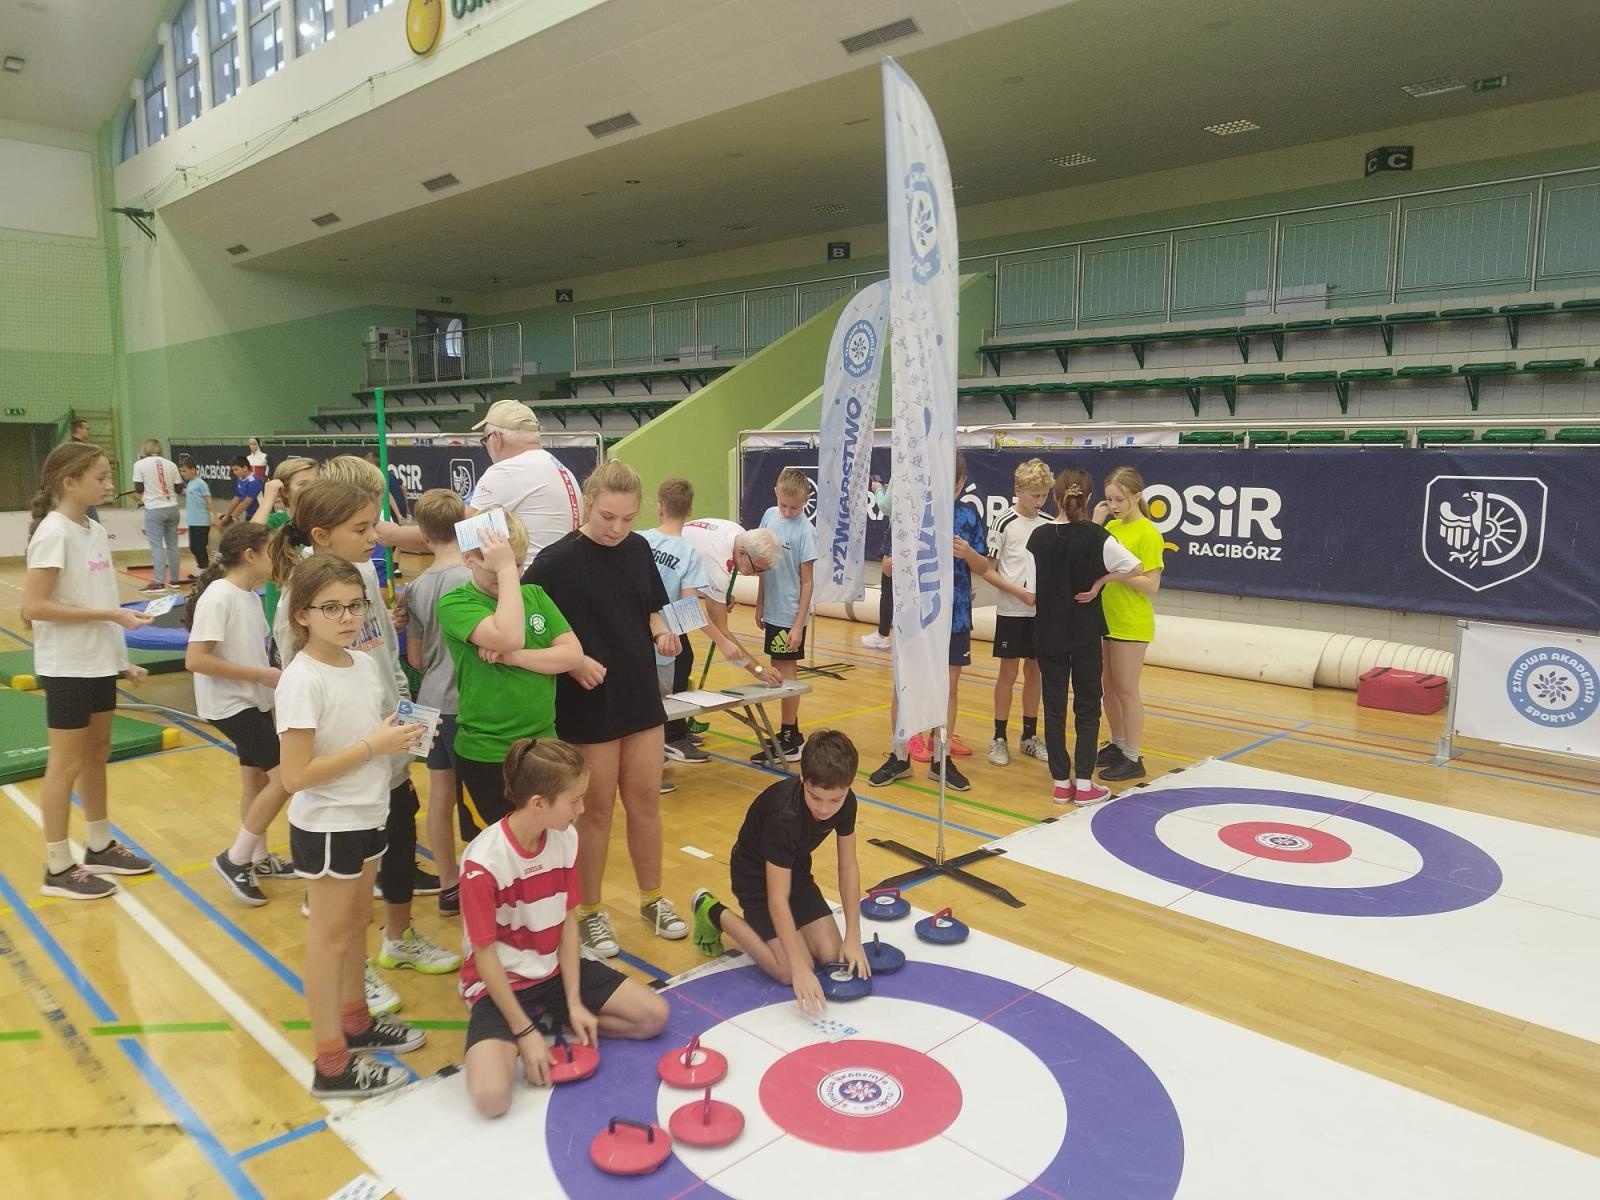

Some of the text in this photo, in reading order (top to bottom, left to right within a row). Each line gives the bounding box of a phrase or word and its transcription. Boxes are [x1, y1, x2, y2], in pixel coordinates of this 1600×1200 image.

[1388, 154, 1407, 168] C
[832, 247, 845, 258] B
[559, 293, 569, 301] A
[1142, 483, 1283, 541] OSiR
[1188, 540, 1282, 561] RACIBÓRZ
[1512, 652, 1595, 704] ZIMOWA AKADEMIA
[1524, 705, 1576, 723] SPORTU
